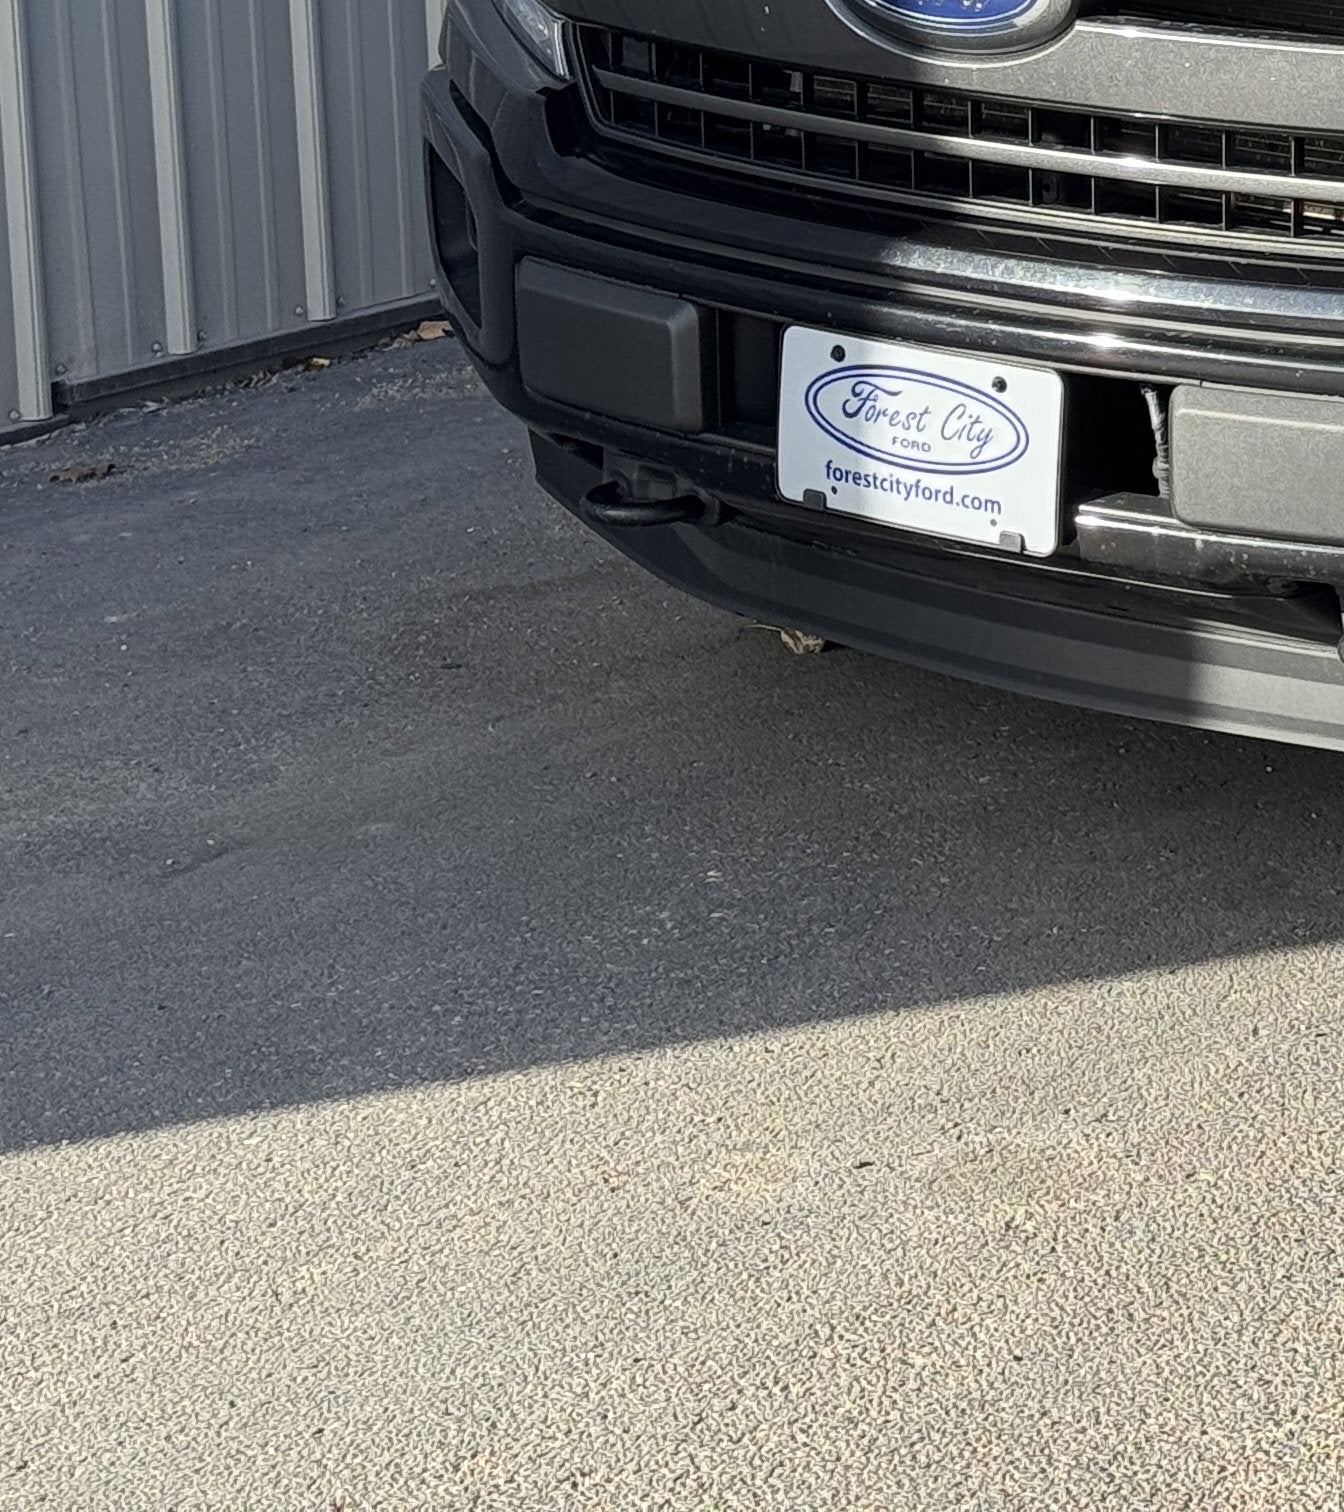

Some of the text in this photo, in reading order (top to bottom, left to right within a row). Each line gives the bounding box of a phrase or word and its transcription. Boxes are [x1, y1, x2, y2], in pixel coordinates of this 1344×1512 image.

[842, 380, 994, 459] Forest City
[891, 435, 931, 454] FORD
[825, 459, 1002, 515] forestcityford.com
